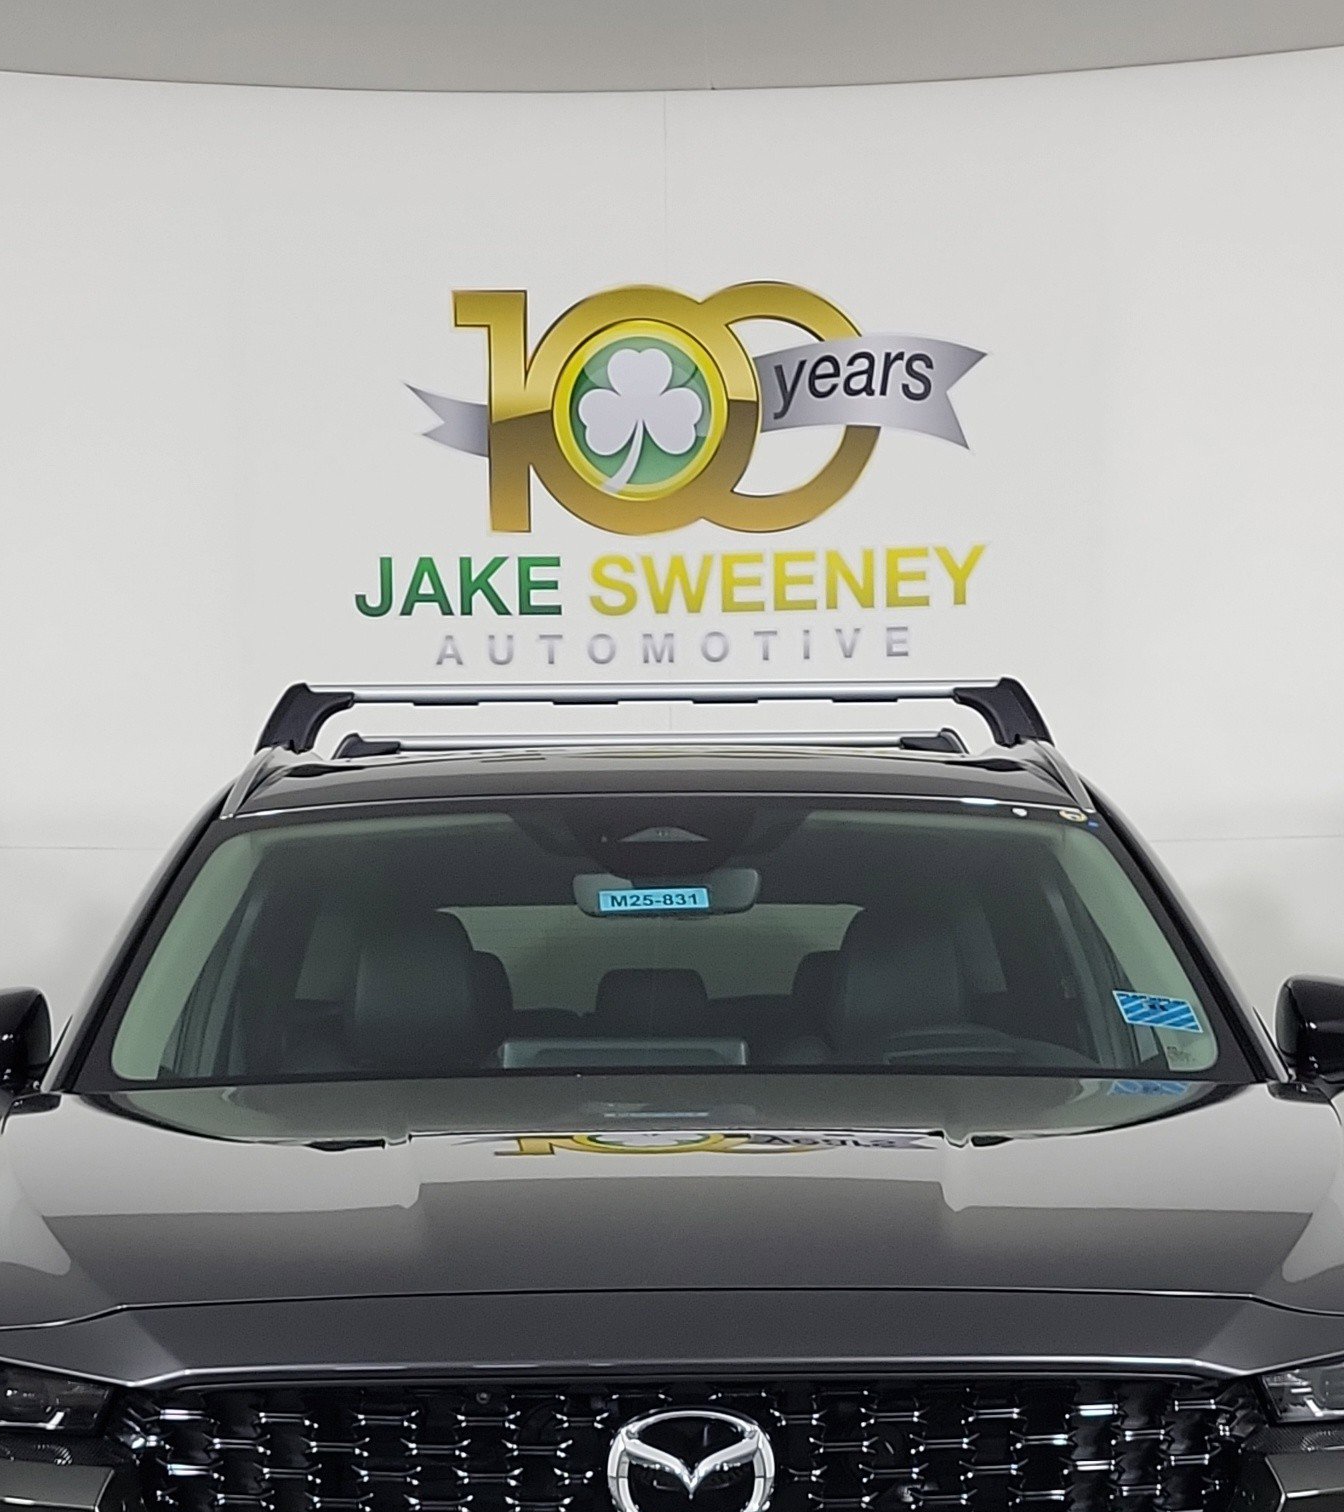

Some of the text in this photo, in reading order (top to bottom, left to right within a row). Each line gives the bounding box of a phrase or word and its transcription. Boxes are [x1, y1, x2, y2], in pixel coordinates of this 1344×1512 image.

[451, 279, 934, 536] 100 years
[354, 544, 986, 618] JAKE SWEENEY
[434, 626, 911, 667] AUTOMOTIVE
[610, 893, 698, 908] M25-831
